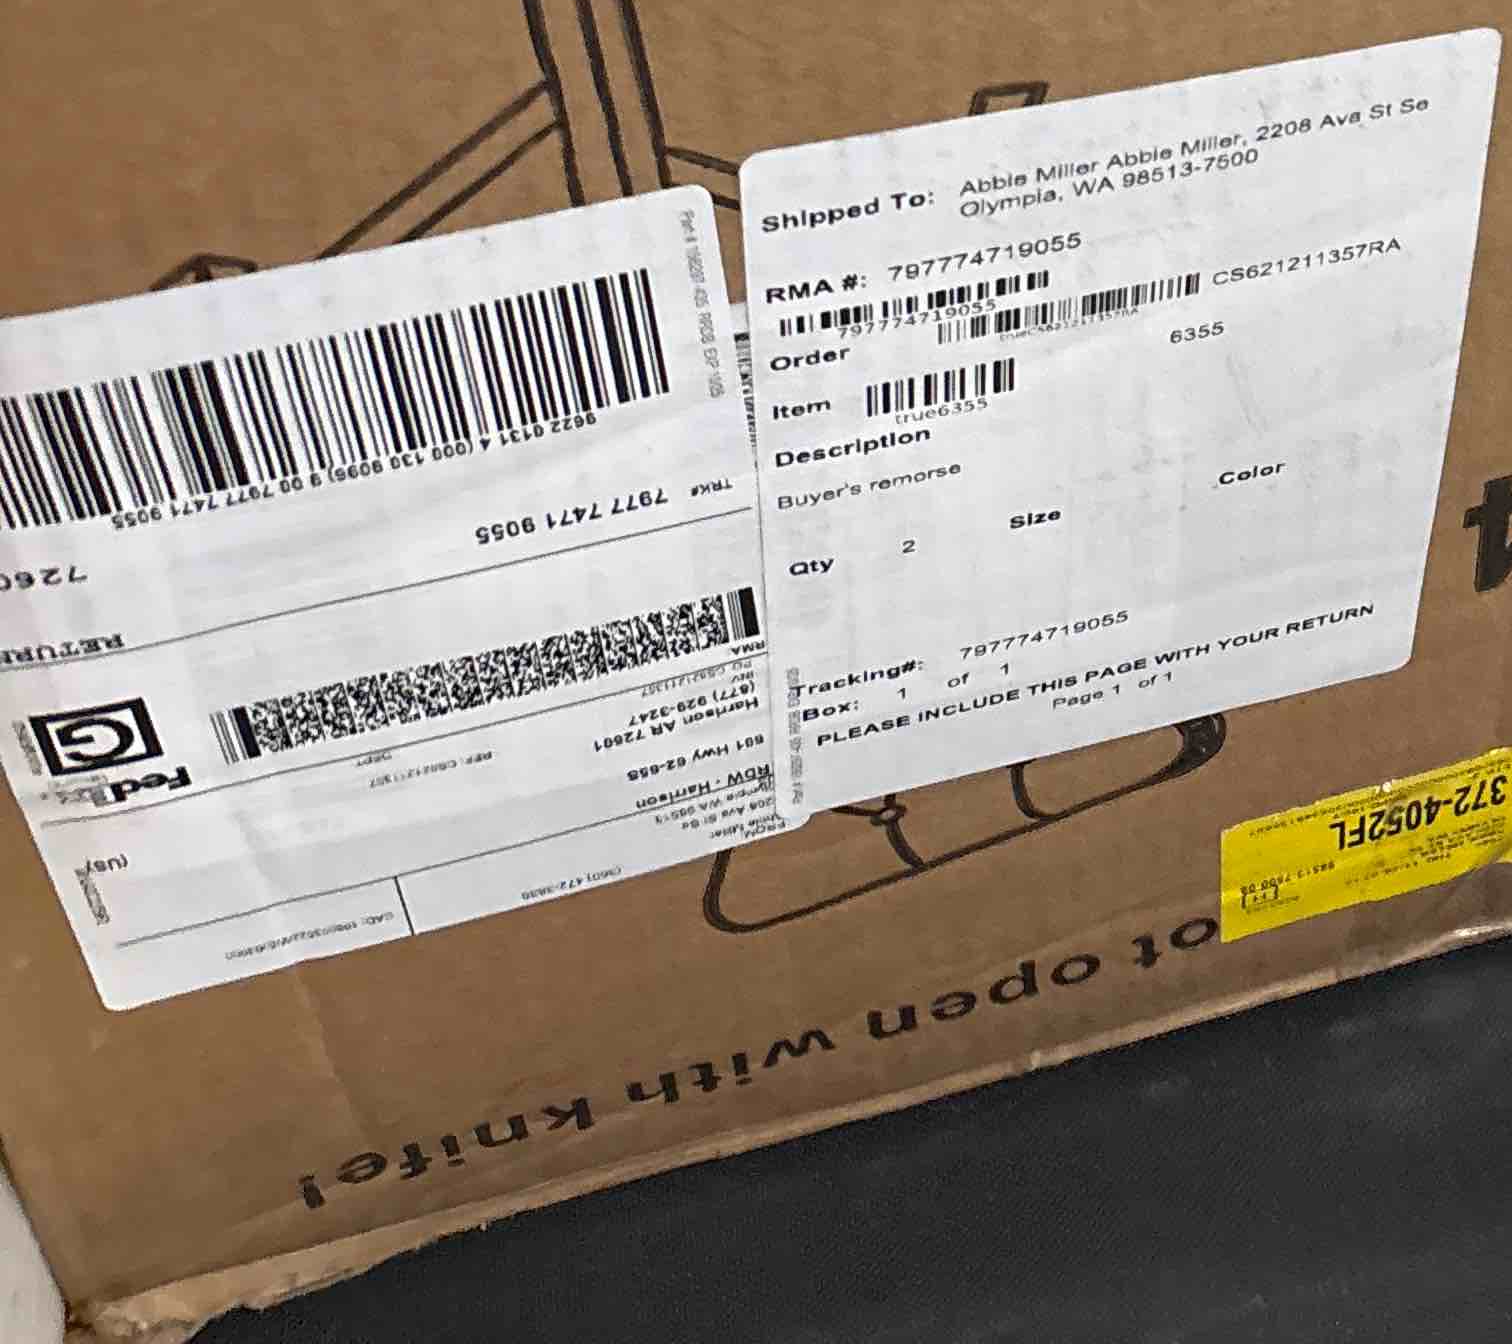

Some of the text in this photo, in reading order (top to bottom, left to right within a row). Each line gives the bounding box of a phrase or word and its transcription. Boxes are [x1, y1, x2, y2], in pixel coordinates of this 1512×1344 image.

[958, 172, 1028, 197] Abbie
[1035, 160, 1098, 183] Miller
[1105, 146, 1173, 171] Abbie
[1254, 117, 1312, 142] 2208
[1318, 110, 1361, 129] Ava
[1368, 102, 1392, 120] St
[761, 190, 933, 233] Shipped To:
[958, 147, 1259, 218] Olympia, WA 98513-7500
[764, 230, 1082, 304] RMA #: 797774719055
[770, 236, 1401, 373] Order CS621211357RA
[772, 320, 1225, 420] Item 6355
[110, 410, 597, 530] 9622 0131 4 (000 130 9096) 9 00 7977 7471 9055
[774, 428, 931, 468] Description
[1217, 462, 1285, 485] Color
[474, 478, 733, 545] TRK# 7977 7471 9055
[776, 462, 961, 510] Buyer's remorse
[1009, 509, 1061, 529] Size
[788, 538, 916, 576] Qty 2
[787, 609, 1129, 698] Tracking#: 797774719055
[816, 603, 1374, 747] PLEASE INCLUDE THIS PAGE WITH YOUR RETURN
[627, 678, 755, 727] (877) 929-3247
[801, 661, 1009, 722] Box: 1 of 1
[1051, 670, 1172, 709] Page 1 of 1
[593, 695, 759, 753] Harrison AR 72601
[691, 742, 729, 762] Hwy
[634, 779, 712, 809] Harrison
[1327, 773, 1508, 851] 372-4052FL
[296, 916, 1217, 1211] ot open with knife!
